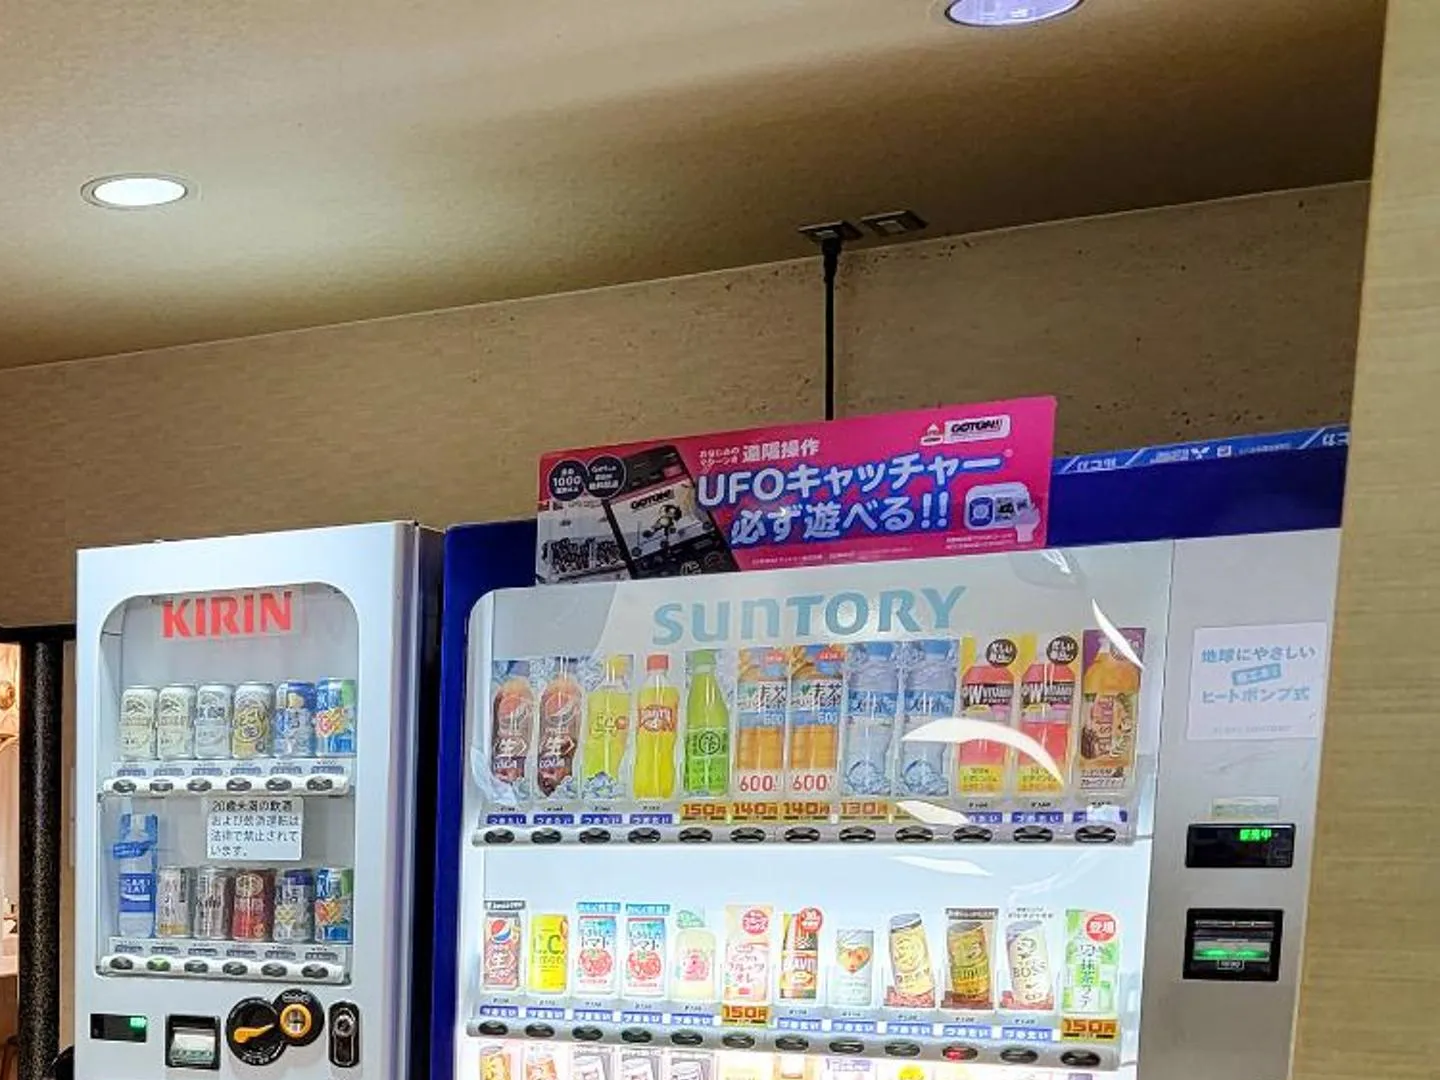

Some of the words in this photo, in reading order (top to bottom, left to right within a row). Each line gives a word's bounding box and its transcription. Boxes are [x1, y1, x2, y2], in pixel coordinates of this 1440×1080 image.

[743, 438, 819, 463] 遠隔操作
[553, 475, 581, 487] 1000
[698, 453, 1001, 506] UFOキャッチャー
[731, 491, 949, 545] 必ず遊べる!!
[162, 591, 293, 639] KIRIN
[652, 586, 966, 646] SUNTORY
[1201, 645, 1316, 663] 地球にやさしい
[1202, 686, 1311, 704] ヒートポンプ式
[740, 775, 773, 792] 600
[793, 774, 827, 791] 600
[682, 803, 727, 815] 150円
[733, 802, 778, 815] 140円
[783, 802, 830, 815] 140円
[723, 1005, 768, 1020] 150円
[1063, 1020, 1117, 1034] 150円
